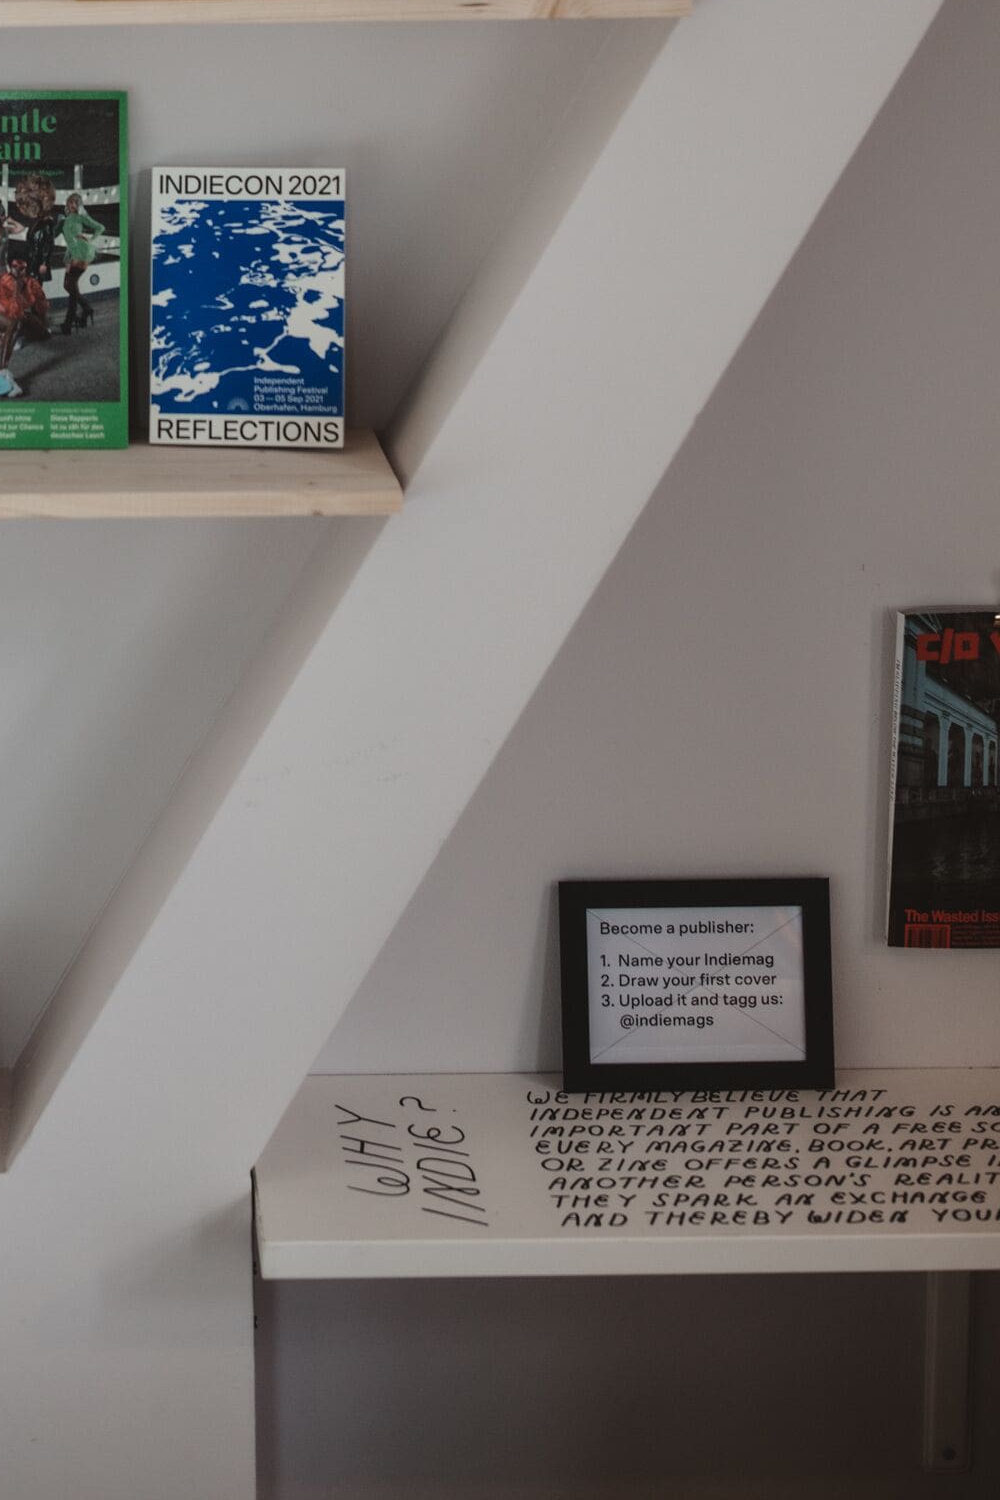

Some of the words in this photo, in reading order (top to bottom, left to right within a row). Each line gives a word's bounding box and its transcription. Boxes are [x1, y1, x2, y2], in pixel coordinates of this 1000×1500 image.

[159, 174, 282, 195] INDIECON
[288, 175, 340, 195] 2021
[253, 376, 304, 386] Independent
[253, 385, 296, 394] Publishing
[296, 385, 328, 394] Festival
[253, 394, 265, 402] 03
[274, 394, 286, 402] 05
[286, 395, 304, 404] Sep
[304, 394, 324, 403] 2021
[300, 404, 337, 413] Hamburg
[156, 418, 340, 442] REFLECTIONS
[904, 907, 929, 922] The
[931, 908, 979, 923] Wasted
[600, 922, 662, 935] Become
[666, 924, 675, 934] a
[679, 921, 754, 936] publisher:
[600, 955, 610, 967] 1.
[619, 954, 663, 967] Name
[667, 956, 700, 969] your
[704, 953, 774, 968] Indiemag
[601, 975, 614, 987] 2.
[619, 974, 660, 986] Draw
[663, 976, 695, 989] your
[700, 974, 730, 985] first
[735, 975, 776, 985] cover
[601, 995, 614, 1007] 3.
[620, 994, 673, 1008] Upload
[677, 994, 687, 1006] it
[691, 994, 719, 1005] and
[723, 994, 757, 1008] tagg
[762, 995, 783, 1005] us:
[620, 1014, 714, 1029] @indiemags
[527, 1091, 569, 1104] WE
[584, 1092, 684, 1103] FIRMLY
[691, 1090, 799, 1103] BELIEVE
[817, 1089, 888, 1101] THAT
[530, 1107, 729, 1121] INDEPENDENT
[744, 1105, 916, 1119] PUBLISHING
[929, 1105, 955, 1117] IS
[964, 1105, 1000, 1117] AN
[530, 1125, 712, 1138] IMPORTANT
[725, 1123, 799, 1136] PART
[813, 1123, 850, 1135] OF
[863, 1123, 880, 1134] A
[892, 1121, 962, 1134] FREE
[335, 1104, 410, 1197] WHY
[535, 1140, 634, 1155] EVERY
[900, 1138, 952, 1150] ART
[399, 1096, 489, 1227] INDIE?
[541, 1158, 585, 1172] OR
[598, 1158, 668, 1172] ZINE
[684, 1157, 799, 1171] OFFERS
[813, 1157, 831, 1169] A
[845, 1155, 971, 1169] GLIMPSE
[548, 1175, 706, 1190] ANOTHER
[724, 1173, 871, 1188] PERSON'S
[550, 1194, 637, 1209] THEY
[652, 1193, 758, 1208] SPARK
[775, 1193, 815, 1206] AN
[830, 1191, 988, 1205] EXCHANGE
[561, 1212, 629, 1227] AND
[644, 1210, 793, 1226] THEREBY
[807, 1210, 909, 1225] WIDEN
